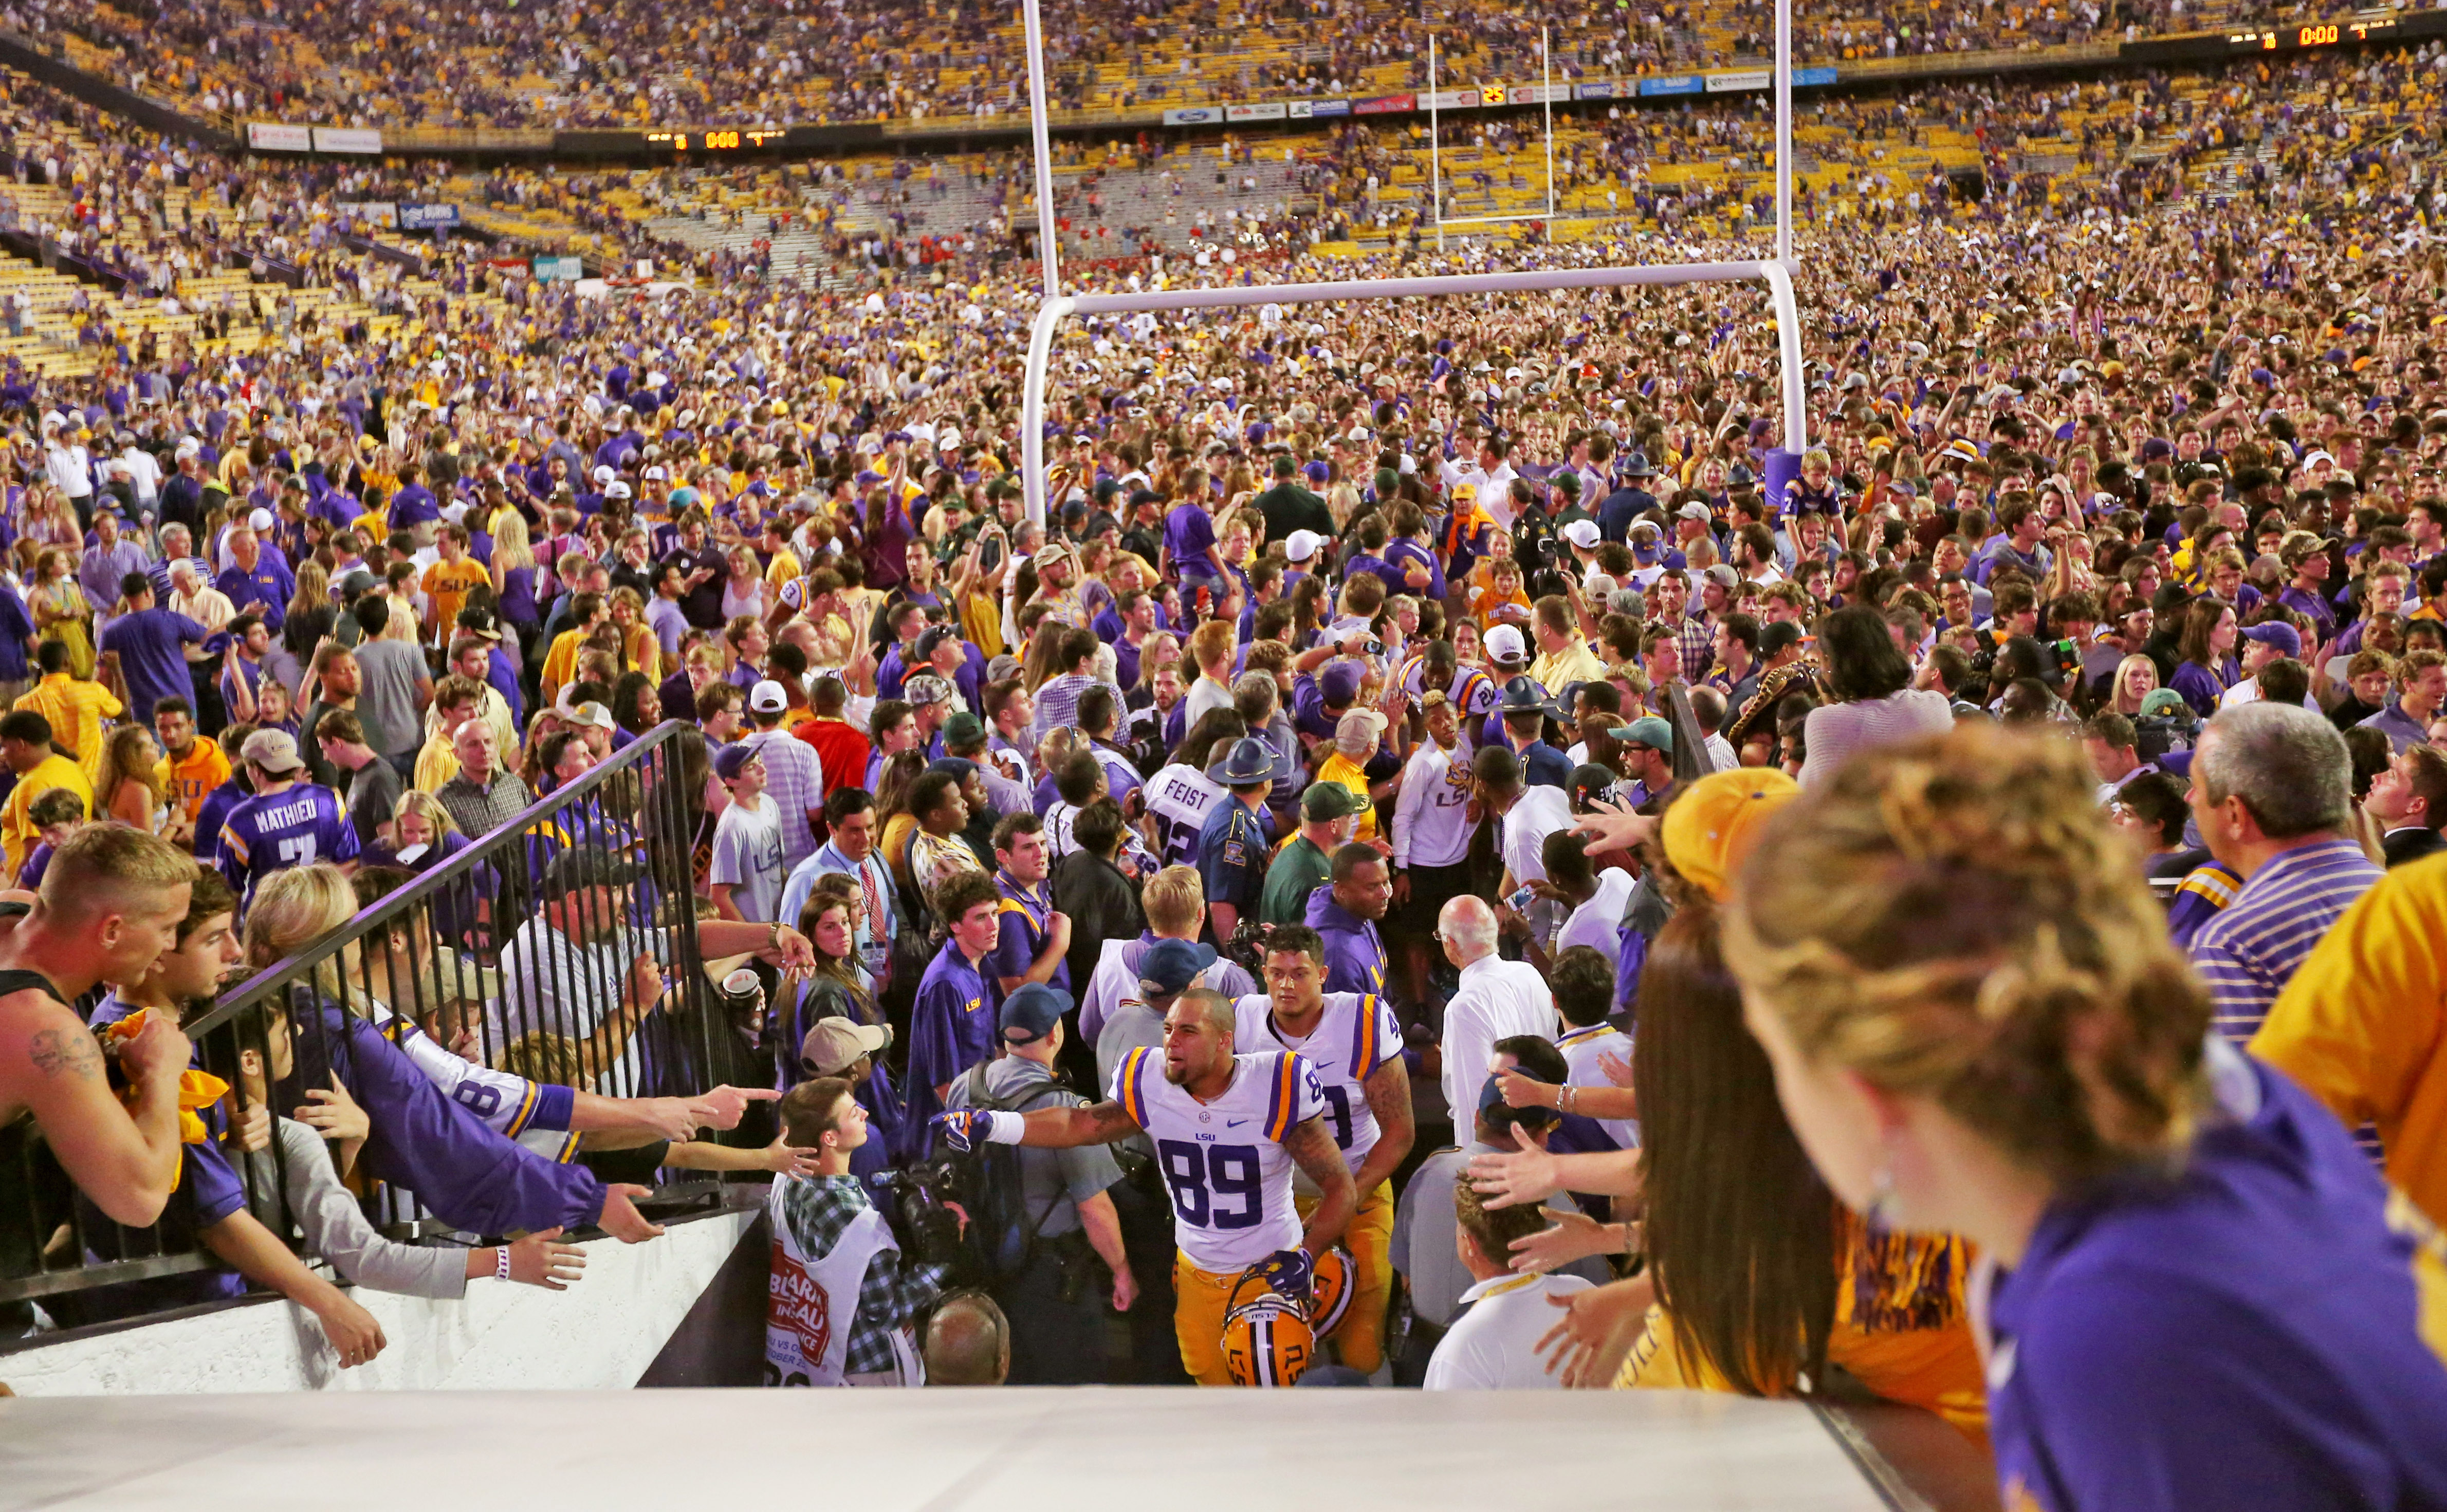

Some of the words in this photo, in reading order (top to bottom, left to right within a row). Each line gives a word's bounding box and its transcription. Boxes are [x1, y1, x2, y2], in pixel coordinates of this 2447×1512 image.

[2299, 25, 2339, 46] 0:00
[1482, 86, 1505, 103] 25
[705, 132, 740, 149] 0:00
[1784, 497, 1793, 512] 7
[1164, 779, 1209, 810] FEIST
[1436, 787, 1469, 807] LS
[253, 798, 318, 834] MATHIEU
[278, 832, 317, 866] 7
[965, 997, 981, 1012] LSU
[1387, 1012, 1400, 1039] 4
[1305, 1070, 1323, 1104] 8
[1195, 1133, 1216, 1142] LSU
[1158, 1139, 1262, 1229] 89
[778, 1339, 789, 1350] VS
